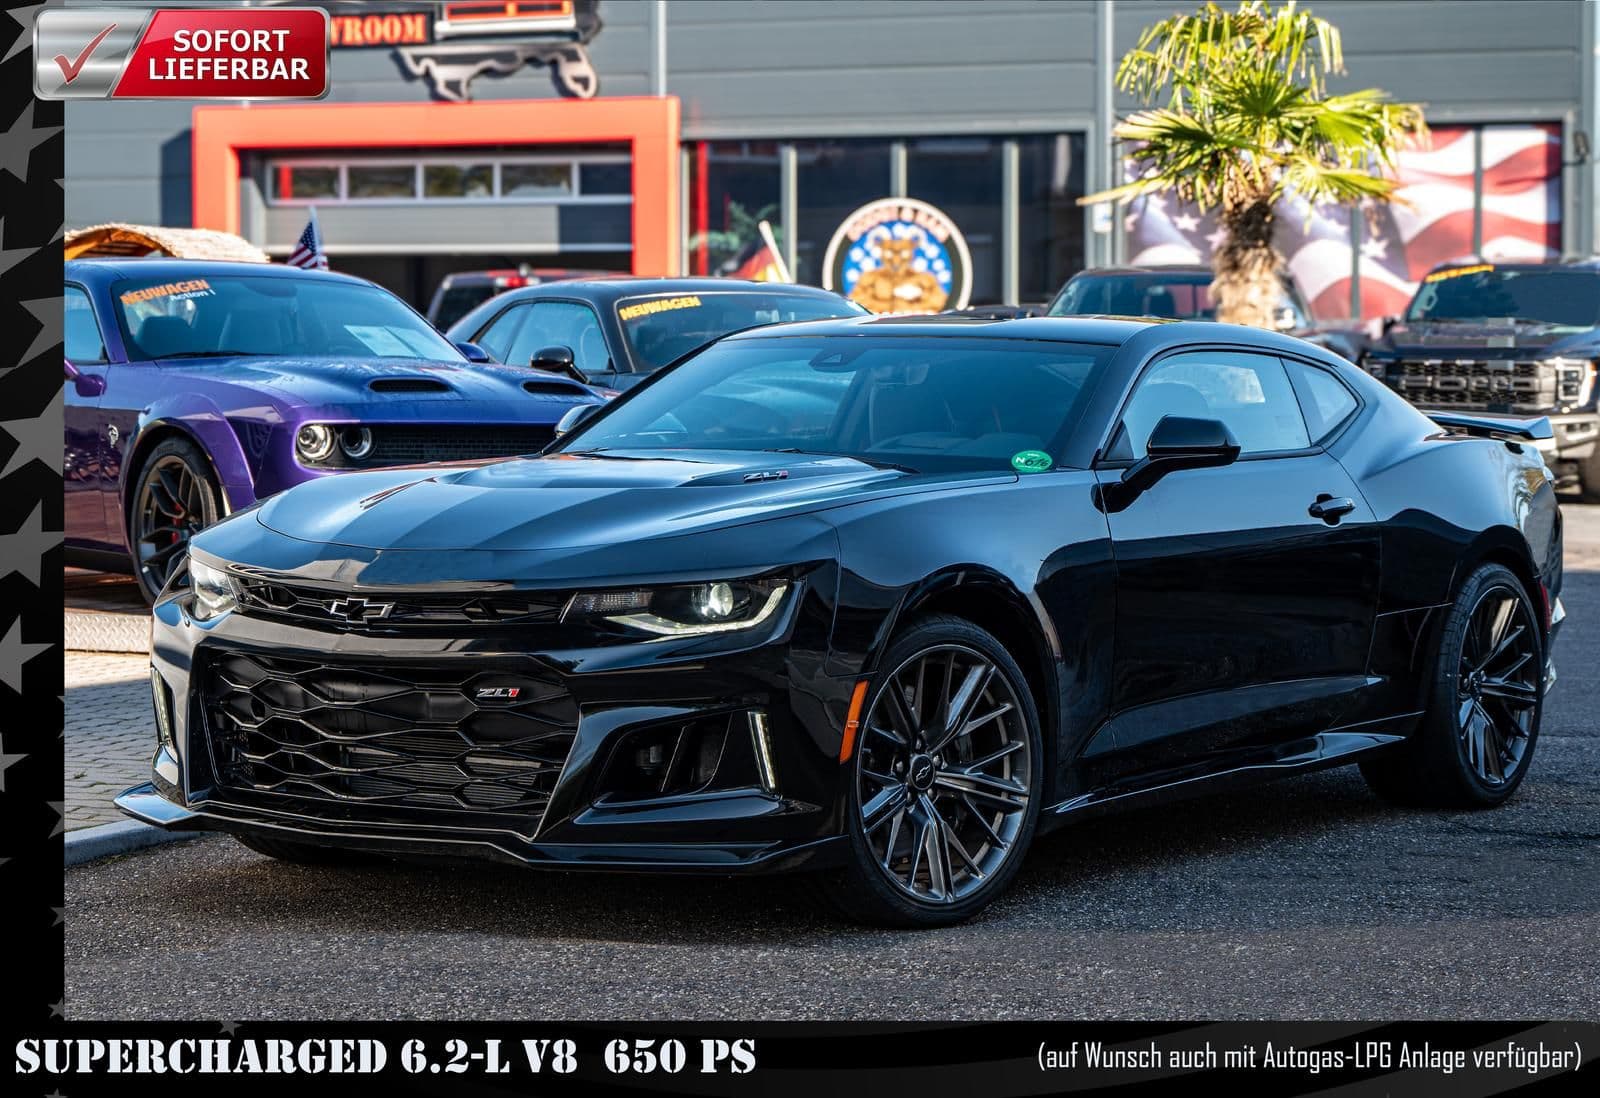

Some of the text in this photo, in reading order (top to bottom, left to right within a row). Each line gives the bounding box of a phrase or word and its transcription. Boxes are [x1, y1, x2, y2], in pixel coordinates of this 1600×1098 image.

[120, 279, 210, 305] NEUWAGEN
[619, 296, 702, 321] NEUWAGEN
[476, 687, 520, 698] ZL1
